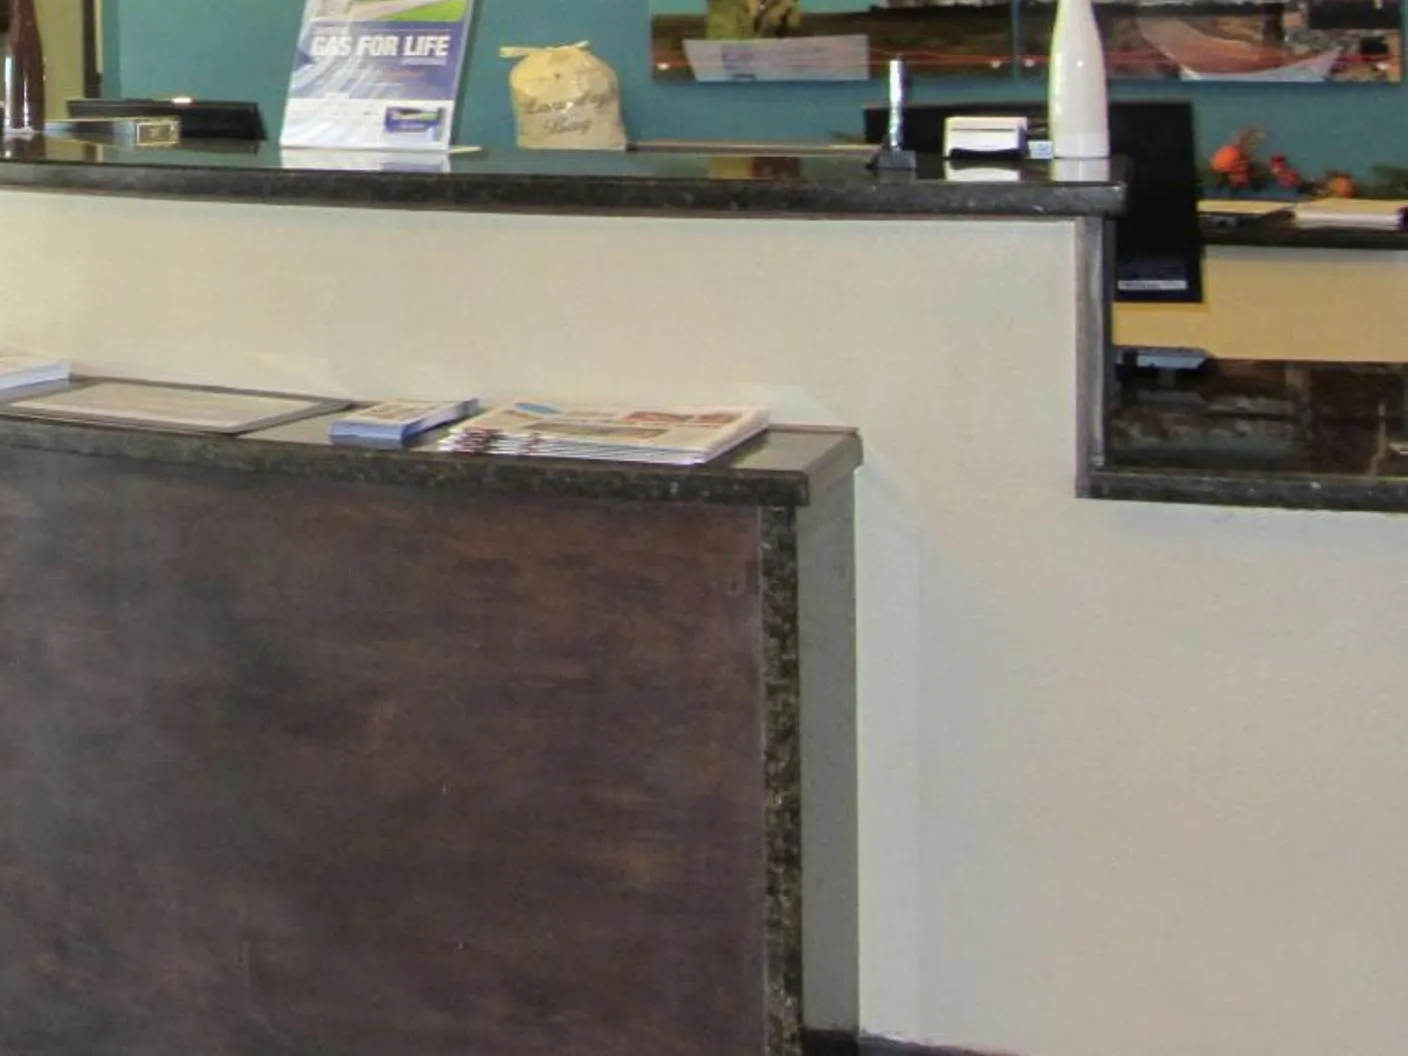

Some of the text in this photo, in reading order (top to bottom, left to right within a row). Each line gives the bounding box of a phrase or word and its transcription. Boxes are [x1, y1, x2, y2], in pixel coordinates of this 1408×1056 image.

[309, 35, 451, 57] GAS FOR LIFE
